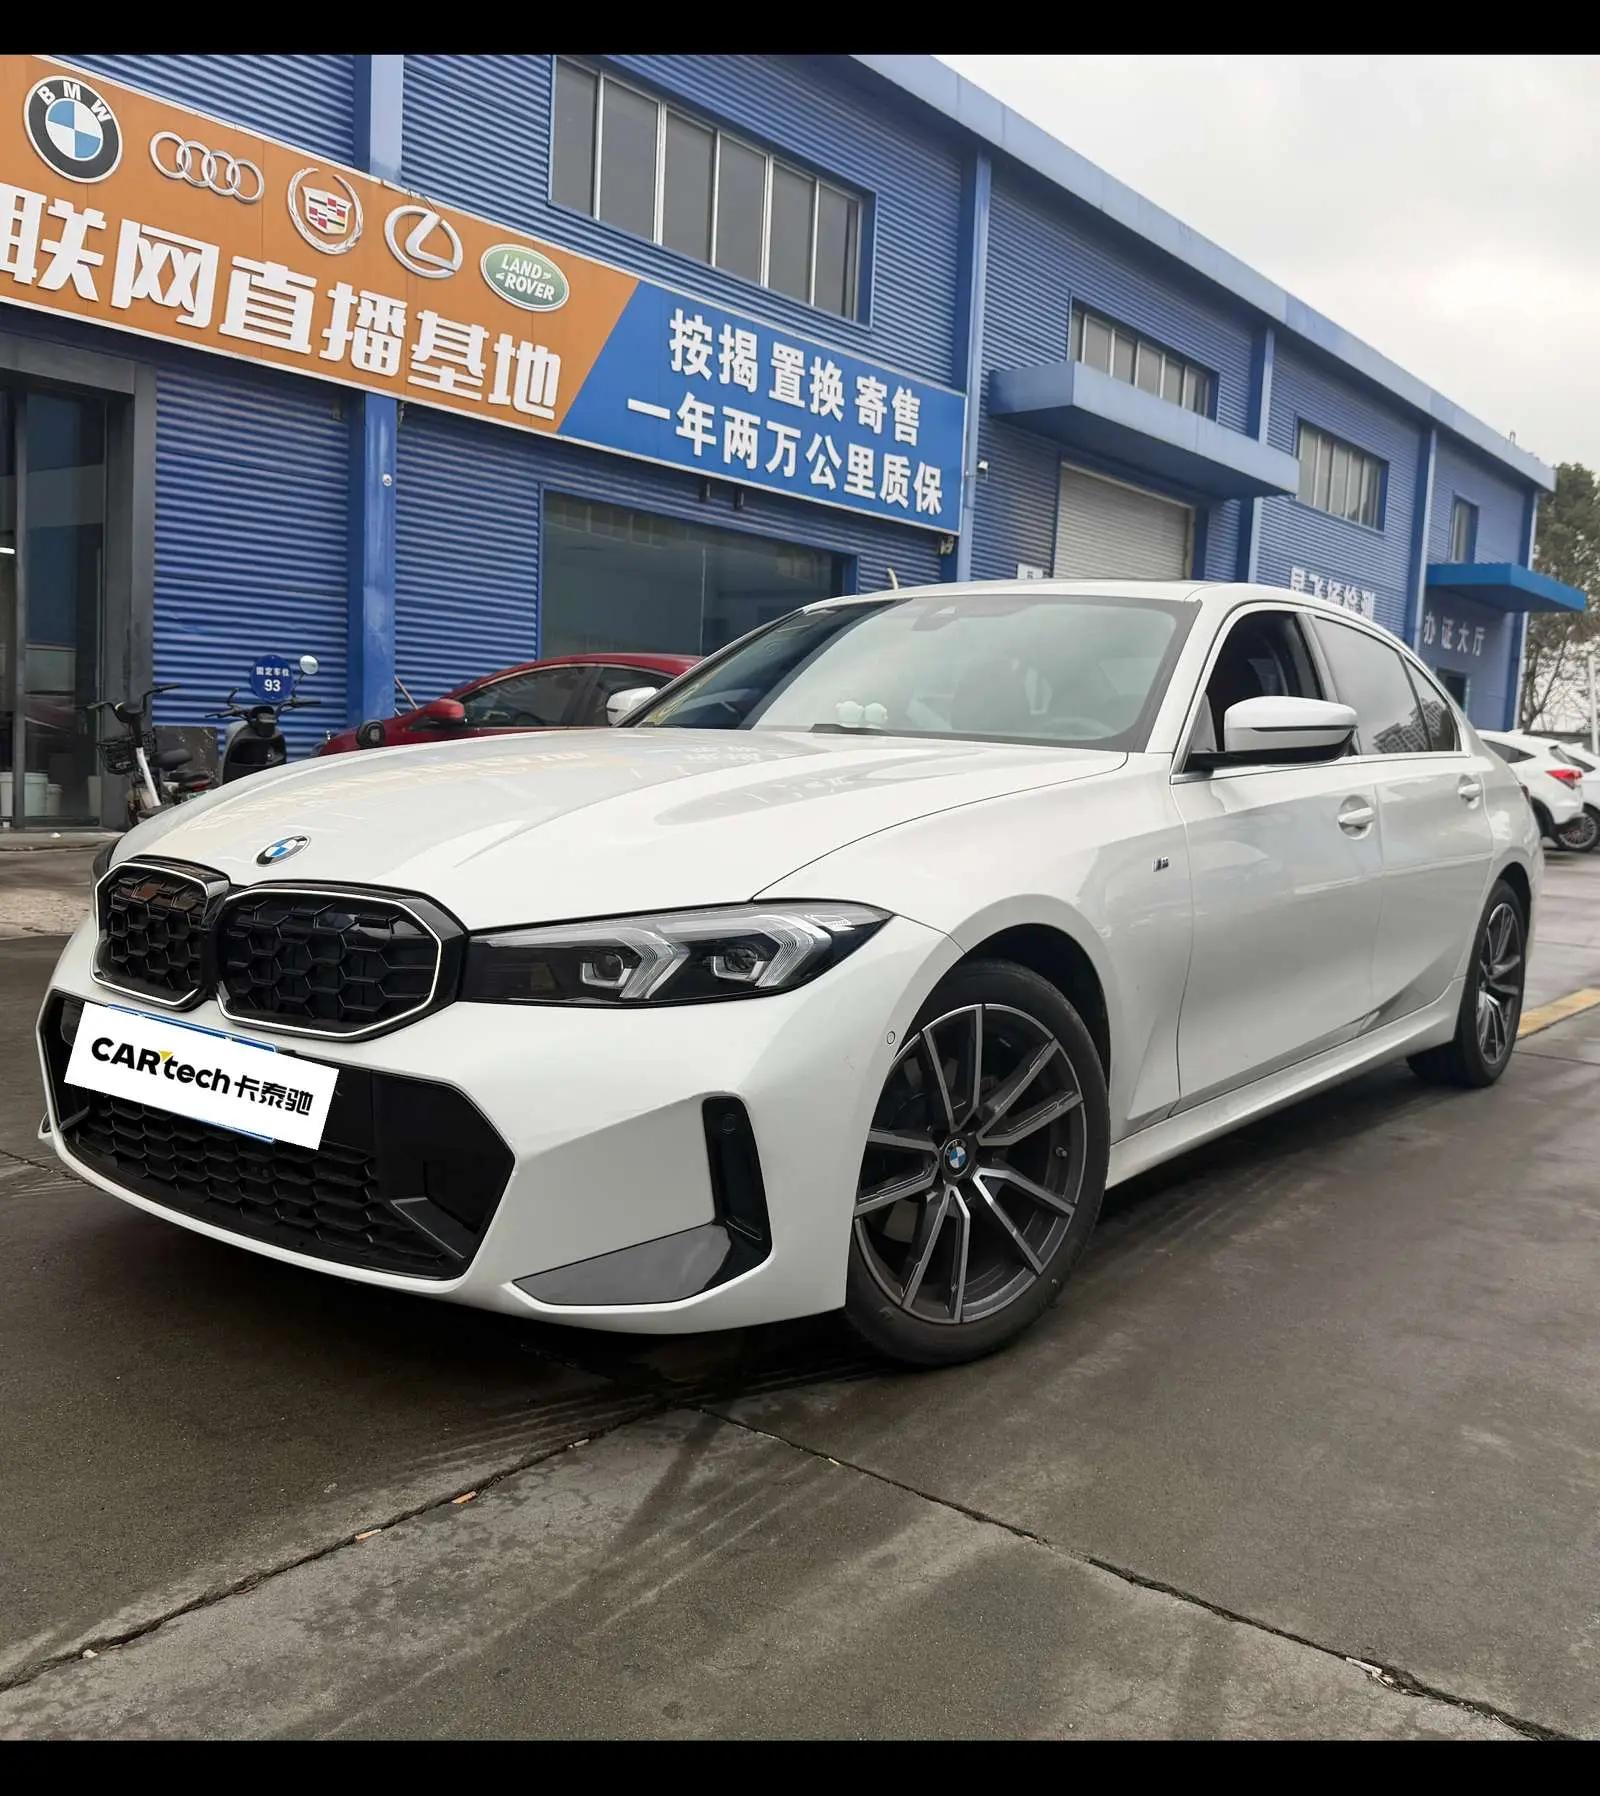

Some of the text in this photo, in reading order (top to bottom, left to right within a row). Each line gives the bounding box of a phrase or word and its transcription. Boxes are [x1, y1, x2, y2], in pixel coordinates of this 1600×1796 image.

[36, 80, 113, 122] BMW
[501, 254, 542, 279] LAND
[504, 271, 555, 301] ROVER
[668, 308, 921, 446] 按揭 置换 寄售
[627, 392, 943, 516] 一年两万公里质保
[1423, 611, 1486, 657] 办证大厅
[264, 679, 281, 692] 93
